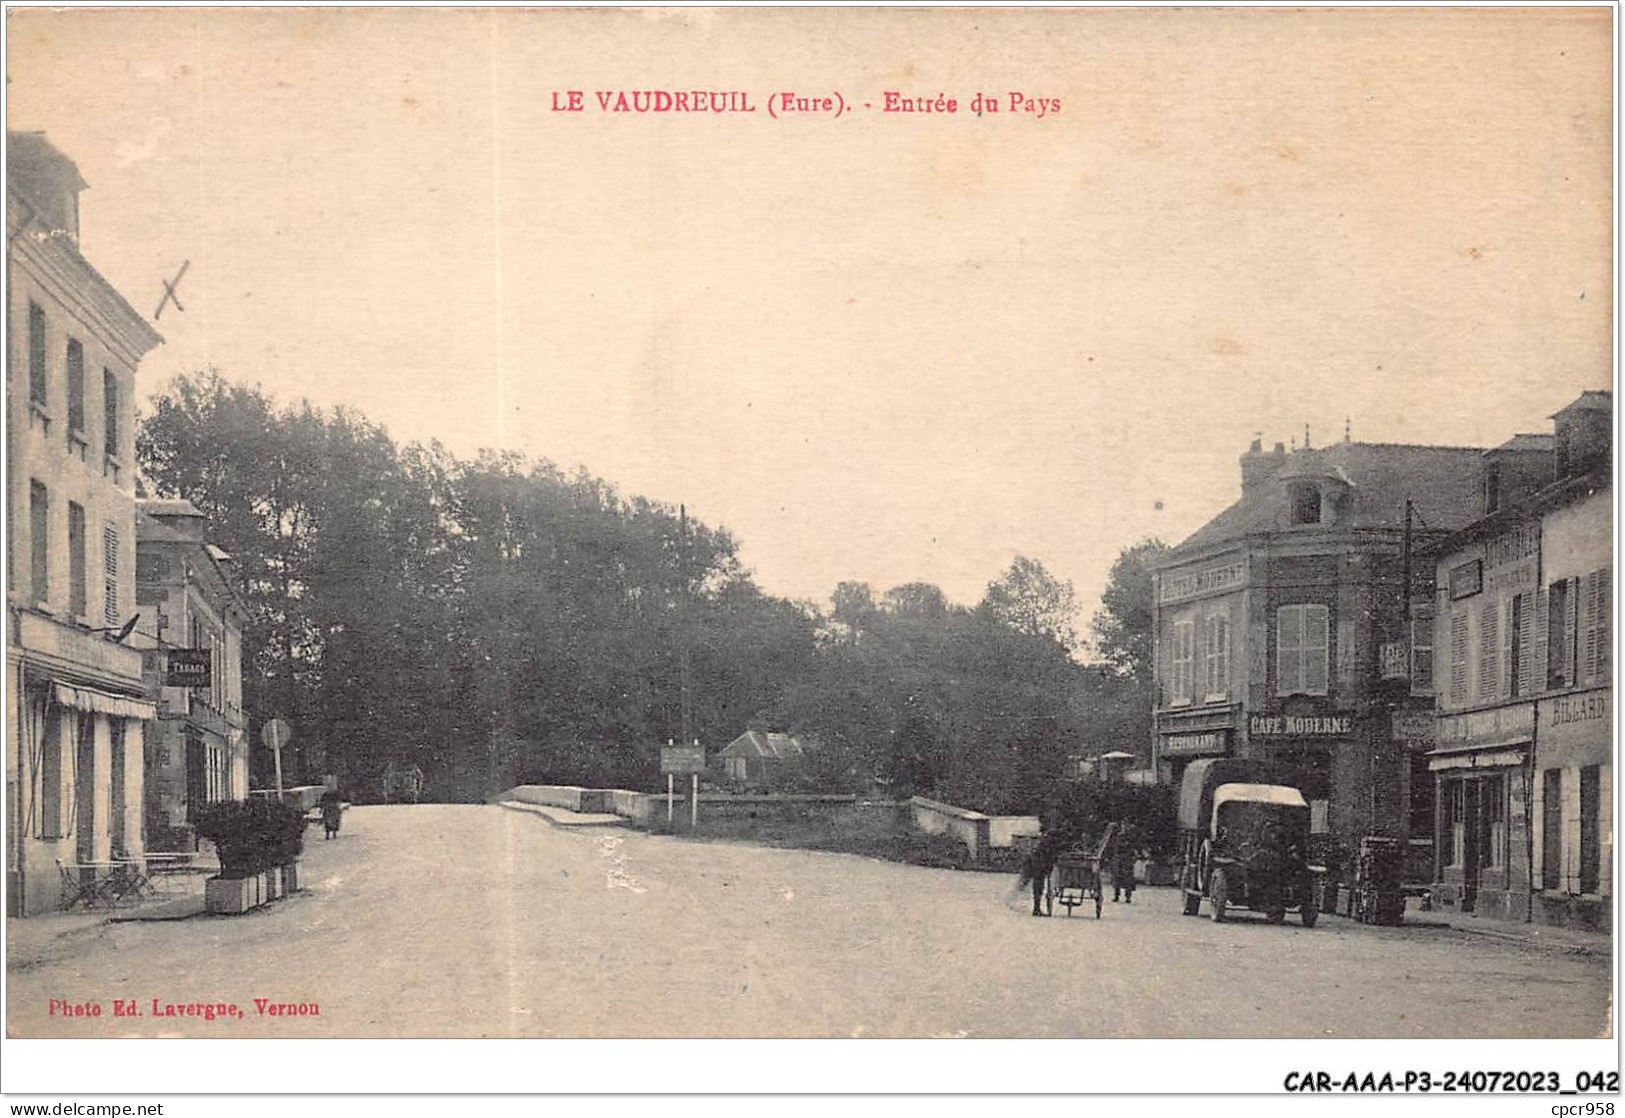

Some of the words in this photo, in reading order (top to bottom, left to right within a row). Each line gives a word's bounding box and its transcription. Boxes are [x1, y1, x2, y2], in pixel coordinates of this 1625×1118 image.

[1551, 698, 1606, 727] BILLARD
[1285, 716, 1352, 734] MODERNE
[1168, 735, 1217, 750] RESTAURANT
